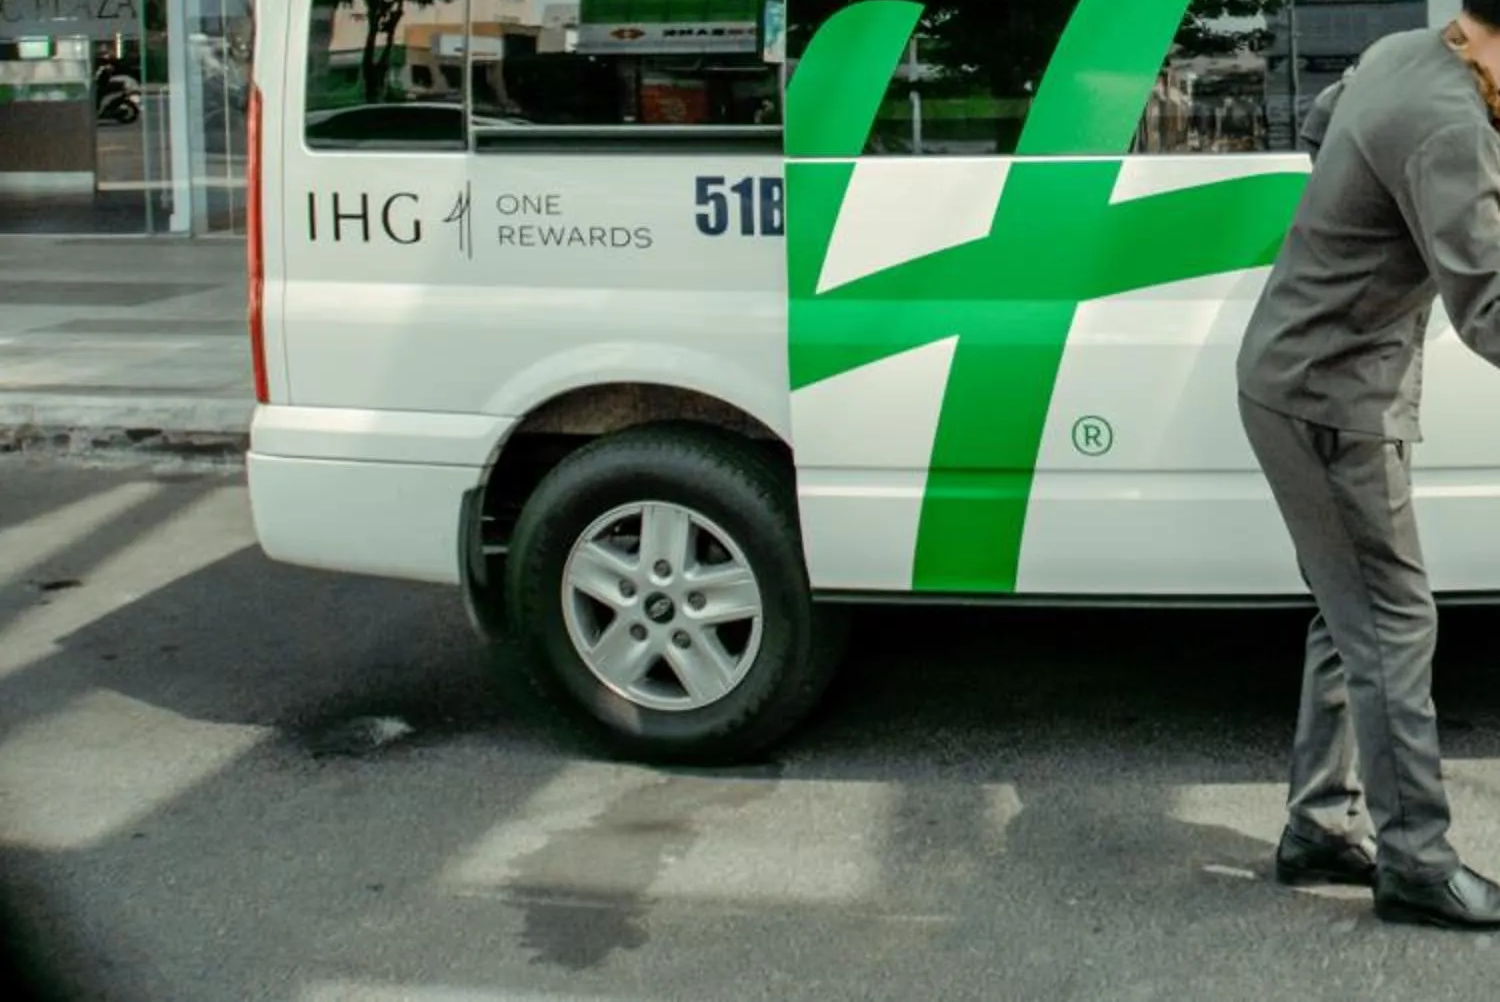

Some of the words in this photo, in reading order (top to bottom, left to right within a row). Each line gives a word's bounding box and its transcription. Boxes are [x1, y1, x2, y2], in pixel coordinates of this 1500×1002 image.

[308, 191, 421, 245] IHG
[496, 194, 562, 216] ONE
[695, 176, 785, 237] 51B
[498, 225, 654, 249] REWARDS
